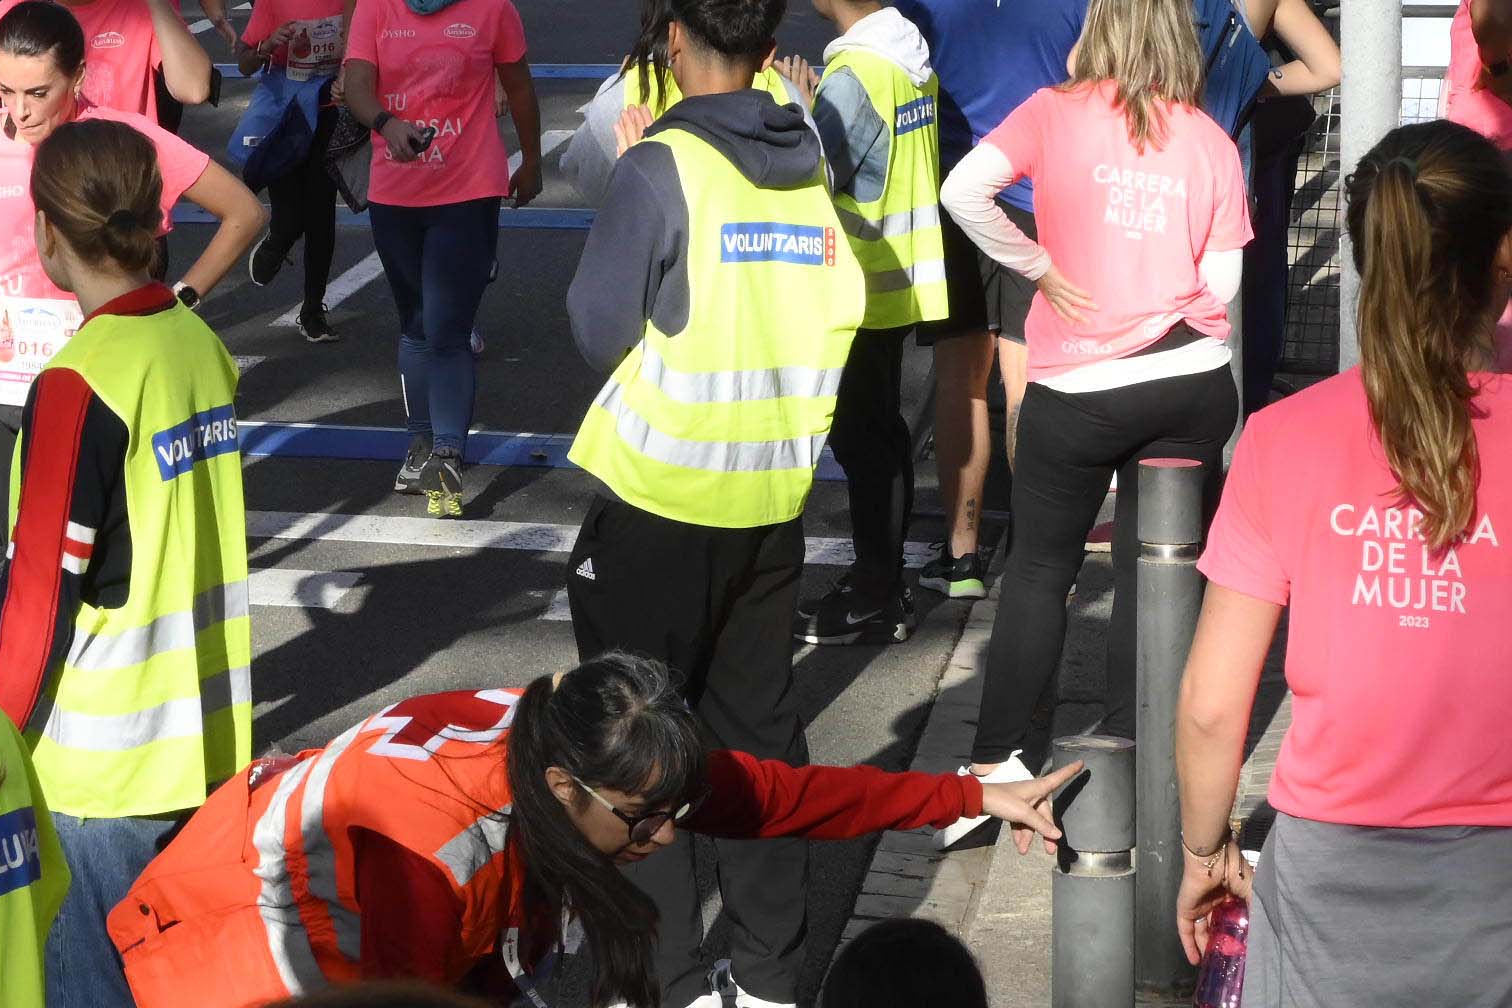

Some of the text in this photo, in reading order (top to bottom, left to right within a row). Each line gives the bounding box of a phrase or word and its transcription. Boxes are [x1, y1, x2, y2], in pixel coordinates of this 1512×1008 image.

[313, 42, 335, 54] 016
[384, 93, 406, 111] TU
[1093, 164, 1186, 199] CARRERA
[1111, 187, 1164, 213] DE LA
[1104, 208, 1167, 234] MUJER
[723, 235, 822, 256] VOLUNTARIS
[19, 341, 53, 357] 016
[1330, 504, 1499, 547] CARRA
[1362, 541, 1463, 578] DE LA
[1352, 574, 1467, 613] MUJER
[1399, 615, 1430, 628] 2023
